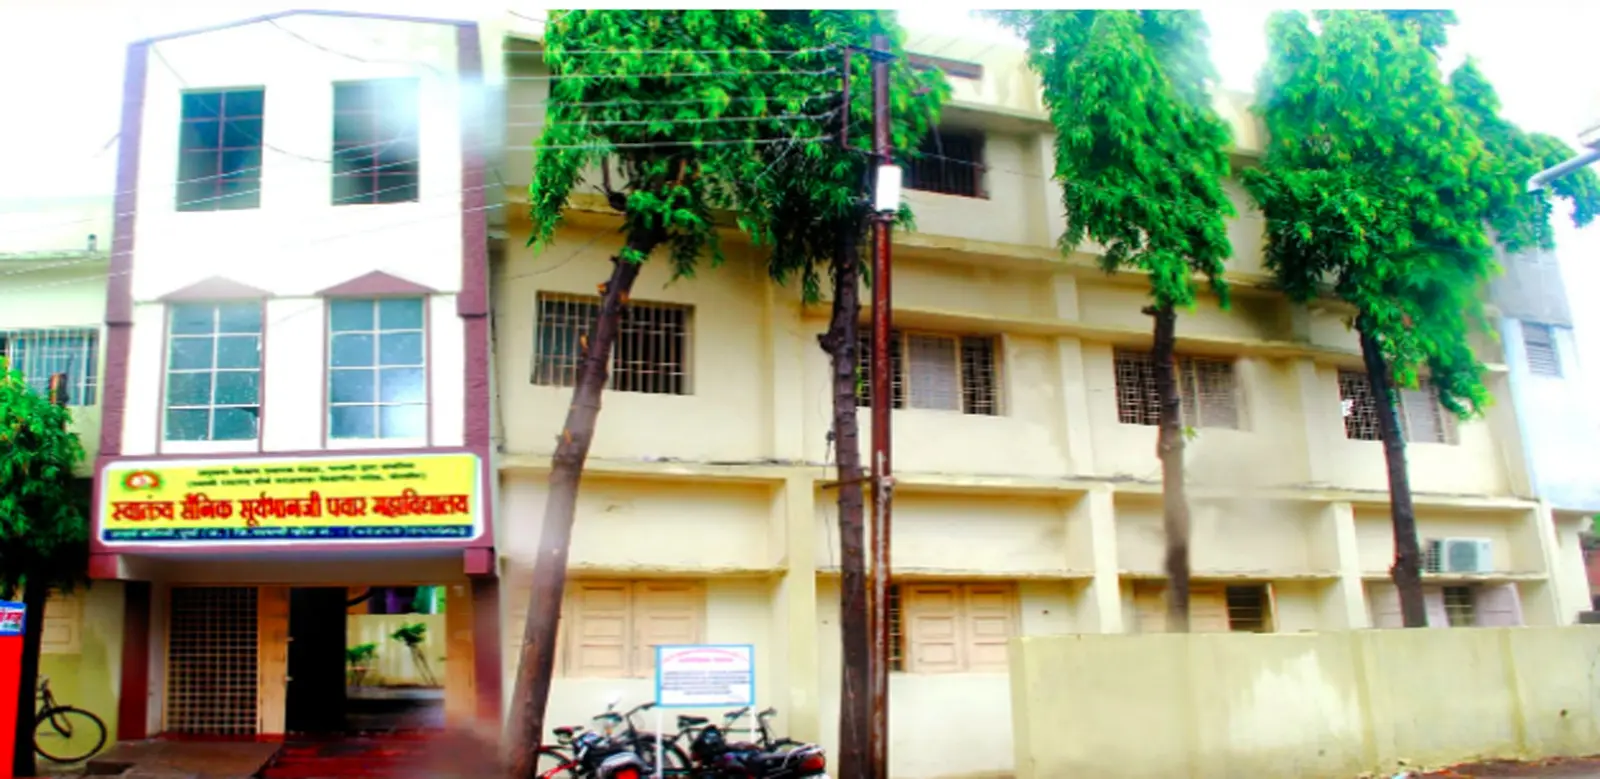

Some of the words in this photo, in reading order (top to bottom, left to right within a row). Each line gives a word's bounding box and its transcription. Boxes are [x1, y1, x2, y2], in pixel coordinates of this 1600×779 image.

[179, 493, 233, 520] सैनिक
[239, 490, 322, 526] सूर्यभानजी
[325, 497, 367, 518] पवार
[371, 488, 469, 519] महाविद्यालय
